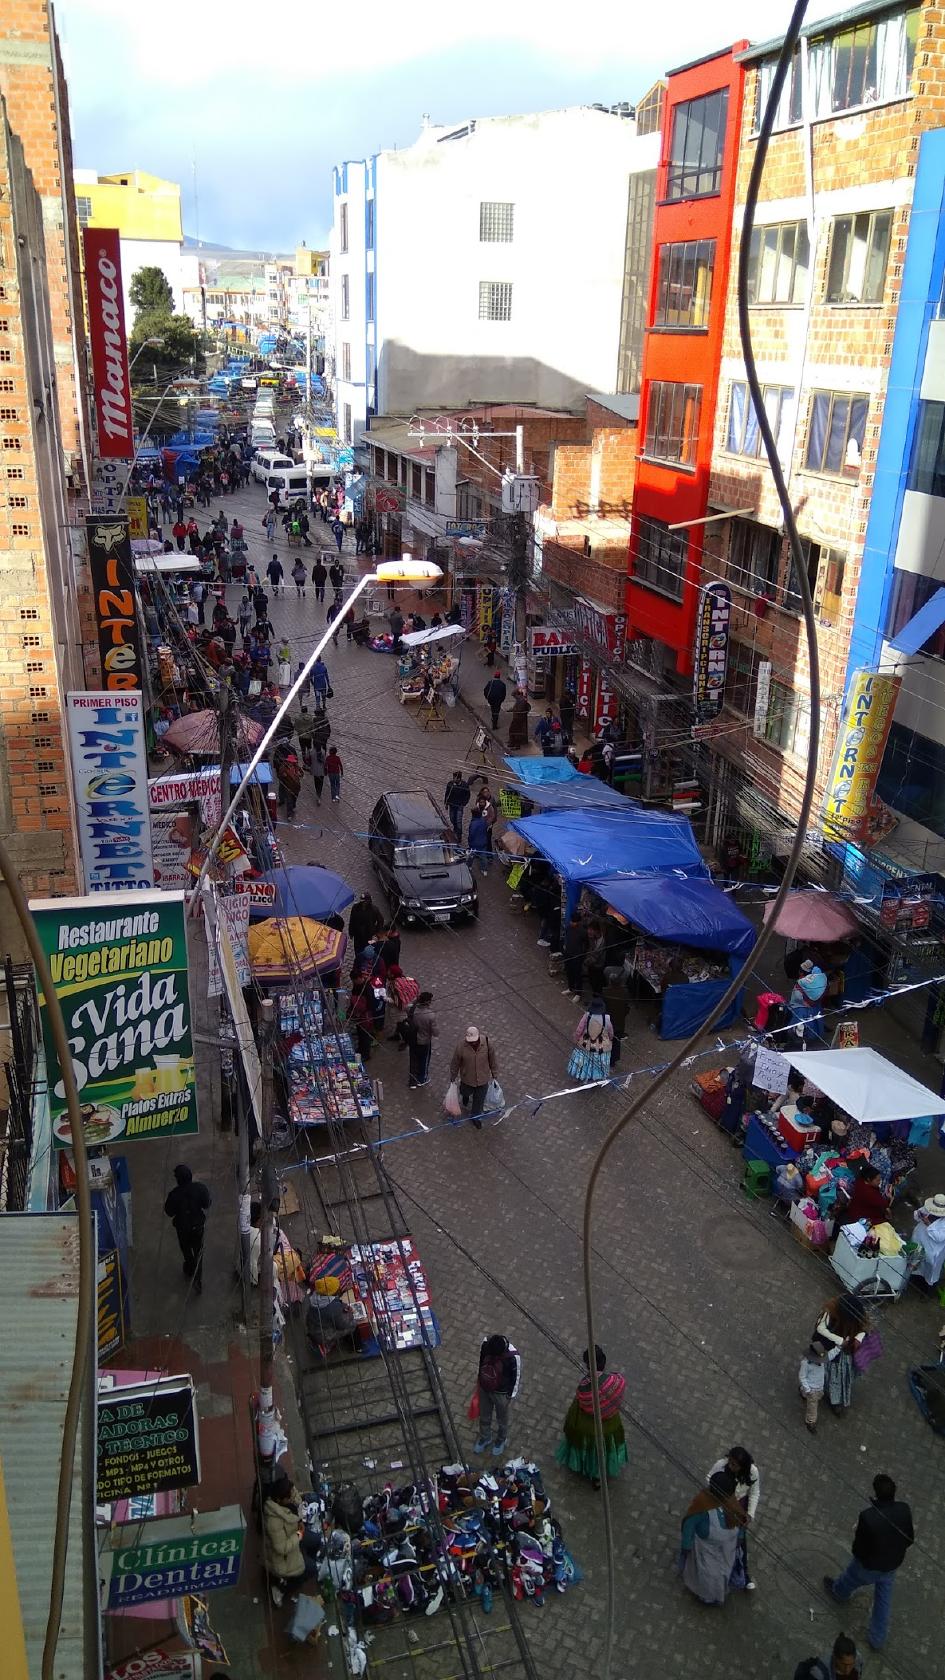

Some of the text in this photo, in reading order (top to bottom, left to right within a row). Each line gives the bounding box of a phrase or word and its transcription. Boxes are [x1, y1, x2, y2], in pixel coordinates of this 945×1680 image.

[73, 698, 138, 707] PRIMER PISO
[150, 782, 186, 803] CENTRO
[58, 911, 160, 950] Restaurante
[50, 937, 173, 984] Vegetariano
[71, 971, 178, 1036] Vida
[54, 1002, 189, 1099] Sana
[121, 1087, 192, 1119] Platos Extras
[125, 1105, 190, 1136] Almuerzo
[117, 1403, 146, 1420] DE
[97, 1413, 179, 1440] ADORAS
[105, 1445, 177, 1466] FONDOS JUEGOS
[106, 1428, 189, 1455] TECNICO
[106, 1466, 124, 1478] MP3
[131, 1463, 149, 1473] MP4
[158, 1455, 185, 1467] OTROS
[113, 1475, 132, 1487] TIPO
[134, 1473, 146, 1483] DE
[147, 1464, 192, 1481] FORMATOS
[118, 1539, 239, 1570] Clínica
[115, 1555, 236, 1594] Dental
